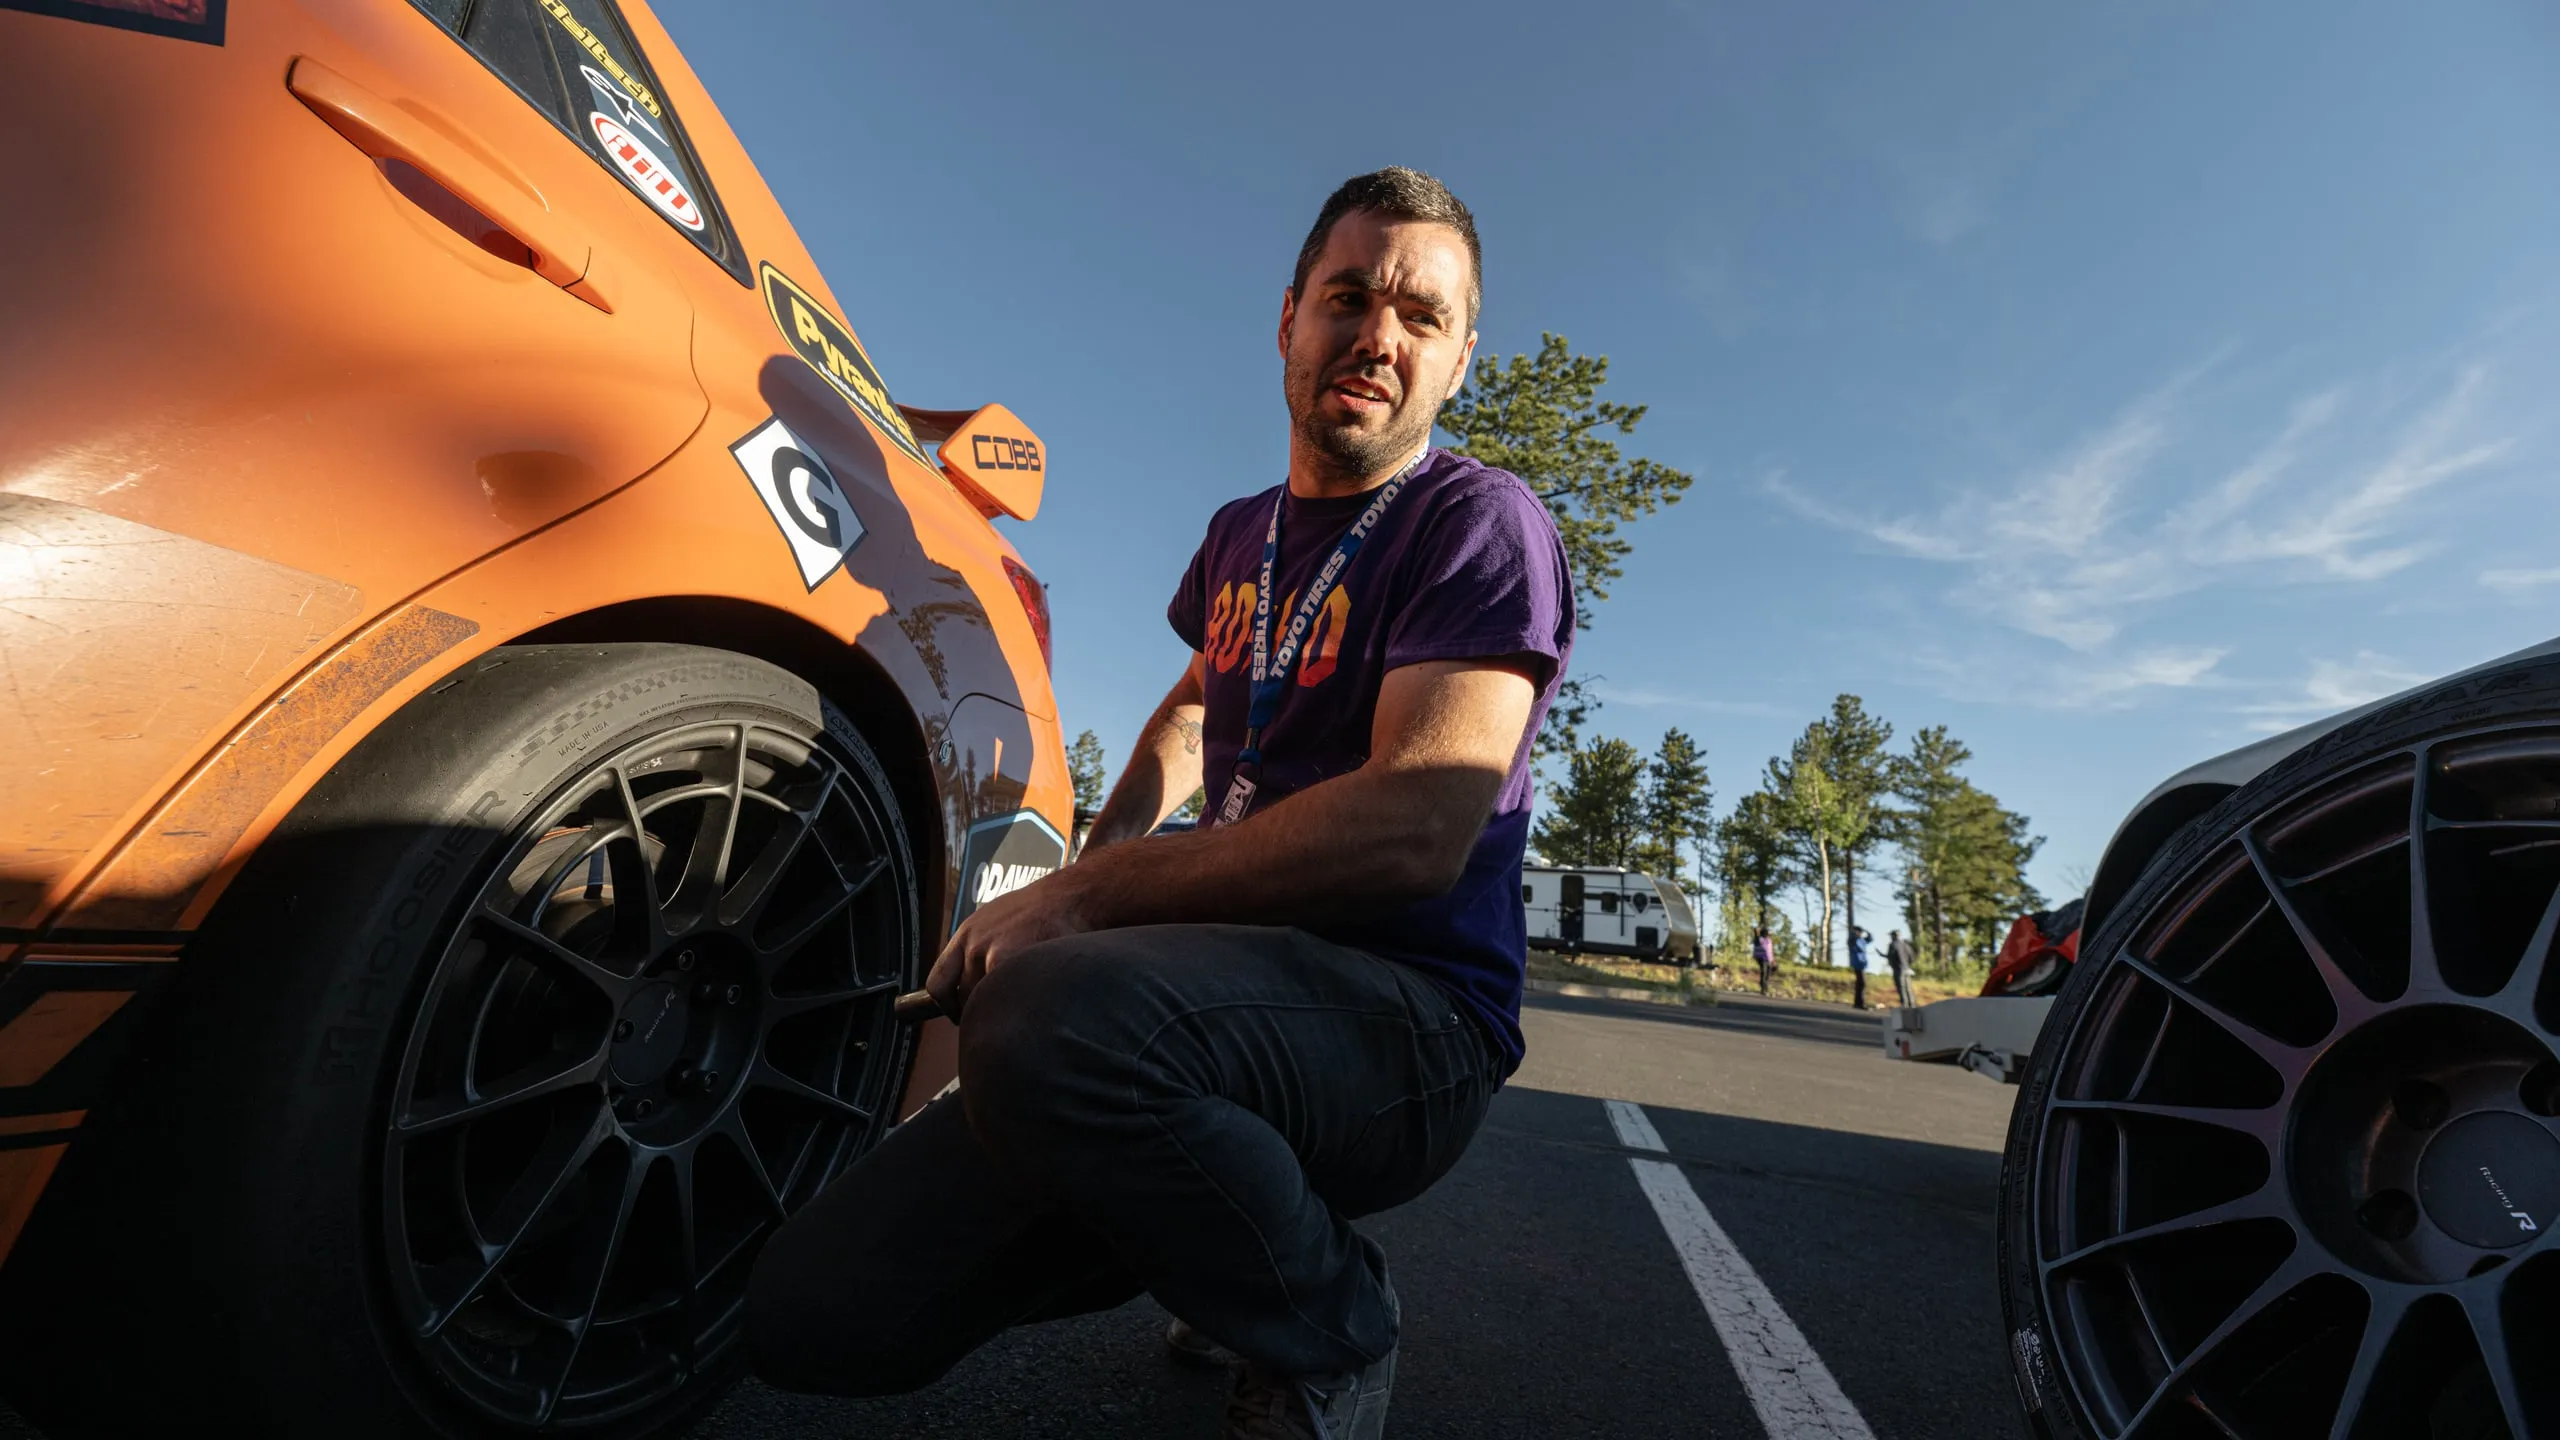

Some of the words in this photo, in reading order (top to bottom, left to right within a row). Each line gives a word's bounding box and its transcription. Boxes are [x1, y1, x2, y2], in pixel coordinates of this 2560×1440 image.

[971, 434, 1041, 472] COBB
[771, 446, 843, 548] G
[1351, 484, 1399, 540] TOYO
[1258, 558, 1273, 616] TOYO
[1269, 614, 1307, 679] TOYO
[1300, 547, 1347, 616] TIRES
[1252, 616, 1268, 682] TIRES
[557, 737, 581, 757] MADE
[581, 730, 592, 741] IN
[592, 720, 610, 734] USA
[345, 789, 507, 1020] HOOSIER
[2510, 1212, 2538, 1231] R
